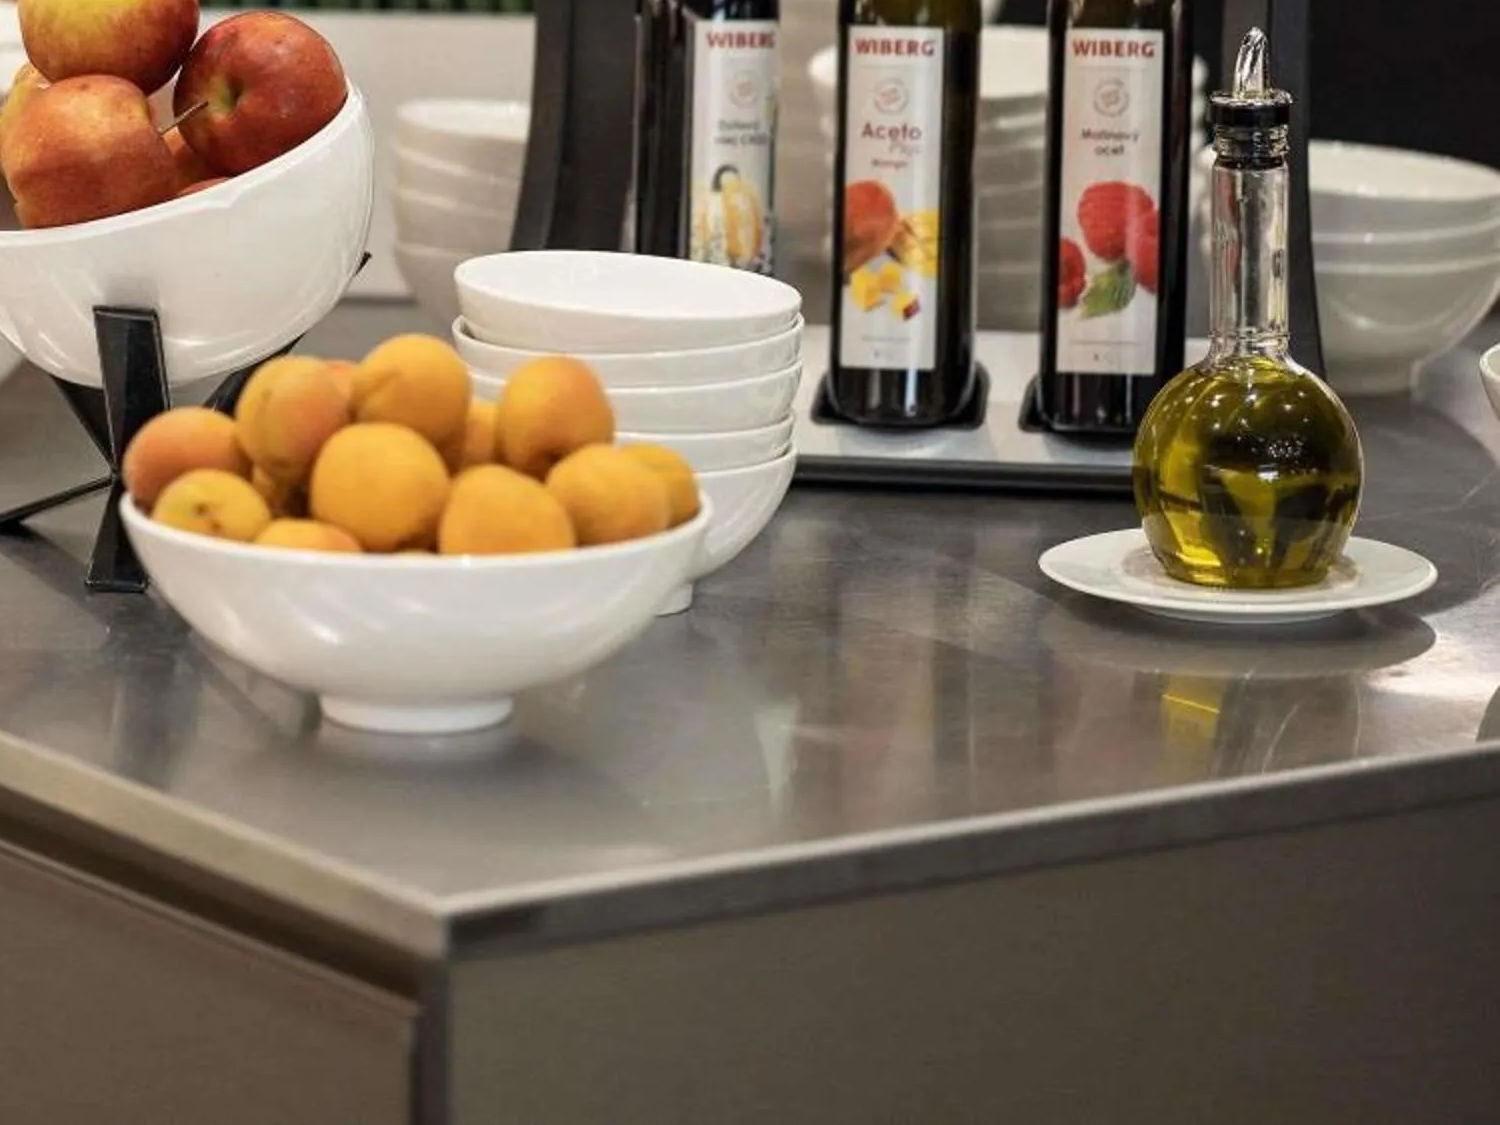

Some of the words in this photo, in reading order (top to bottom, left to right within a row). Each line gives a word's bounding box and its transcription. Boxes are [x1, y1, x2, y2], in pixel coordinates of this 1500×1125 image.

[854, 38, 935, 56] WIBERG
[1073, 39, 1157, 58] WIBERG
[861, 122, 922, 140] Aceto
